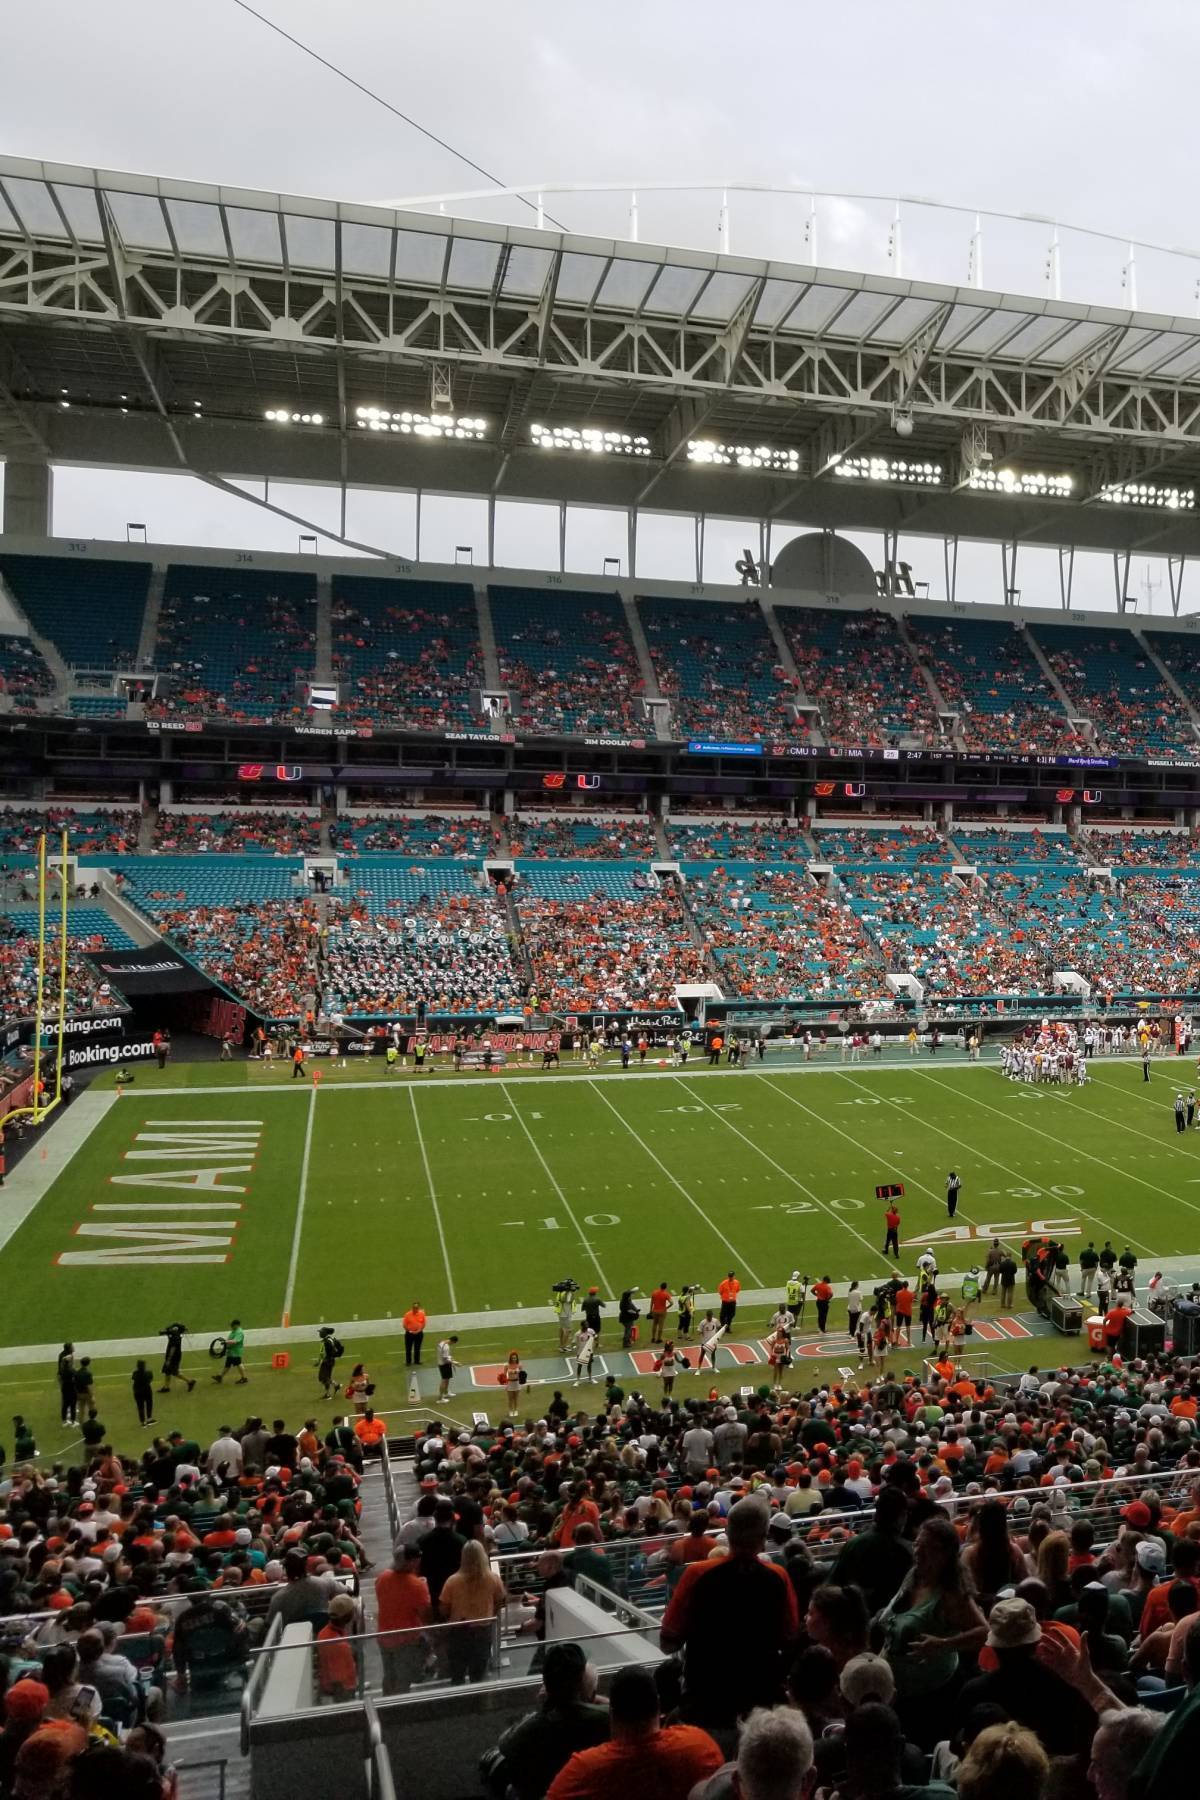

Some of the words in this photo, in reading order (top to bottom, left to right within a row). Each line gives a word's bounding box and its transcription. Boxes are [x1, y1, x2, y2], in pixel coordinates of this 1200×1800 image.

[69, 543, 87, 552] 313
[235, 553, 254, 562] 314
[547, 575, 562, 584] 316
[146, 721, 160, 730] ED
[161, 722, 185, 731] REED
[294, 727, 333, 736] WARREN
[333, 728, 358, 737] SAPP
[445, 732, 467, 741] SEAN
[468, 733, 500, 742] TAYLOR
[584, 738, 598, 746] JIM
[599, 739, 631, 747] DOOLEY
[790, 747, 809, 755] CMU
[848, 749, 863, 757] MIA
[907, 751, 922, 759] 2:47
[39, 1017, 122, 1035] Booking.com
[69, 1041, 155, 1065] Booking.com
[52, 1119, 265, 1266] MIAMI
[900, 1218, 1082, 1245] ACC
[1117, 1279, 1129, 1290] 44
[1091, 1328, 1104, 1342] G
